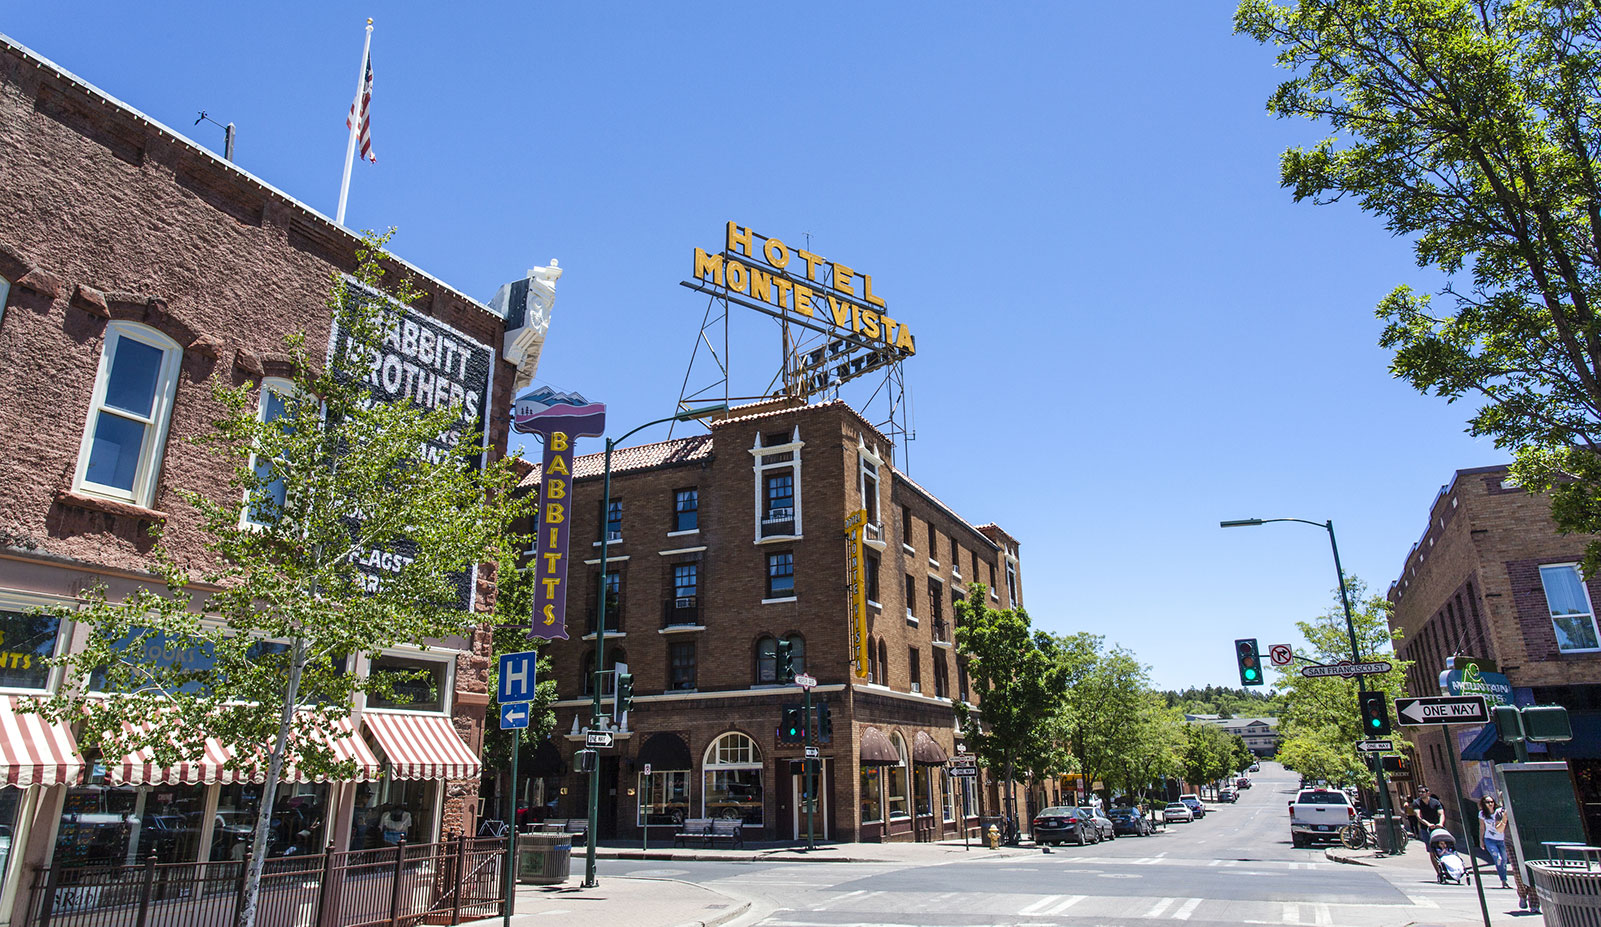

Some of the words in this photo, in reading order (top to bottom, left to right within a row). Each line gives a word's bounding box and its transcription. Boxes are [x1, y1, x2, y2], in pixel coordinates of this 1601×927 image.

[727, 219, 885, 308] HOTEL
[693, 247, 814, 317] MONTE
[827, 295, 916, 354] VISTA
[365, 302, 472, 382] ABBITT
[541, 431, 570, 627] BABBITTS
[851, 529, 859, 595] MONTE
[854, 603, 862, 672] VISTA
[1308, 668, 1325, 676] SAN
[1327, 665, 1373, 675] FRANCISCO
[1373, 663, 1385, 671] ST
[505, 659, 528, 695] H
[1422, 705, 1448, 717] ONE
[1450, 704, 1476, 715] WAY
[1451, 680, 1510, 694] MOUNTAIN
